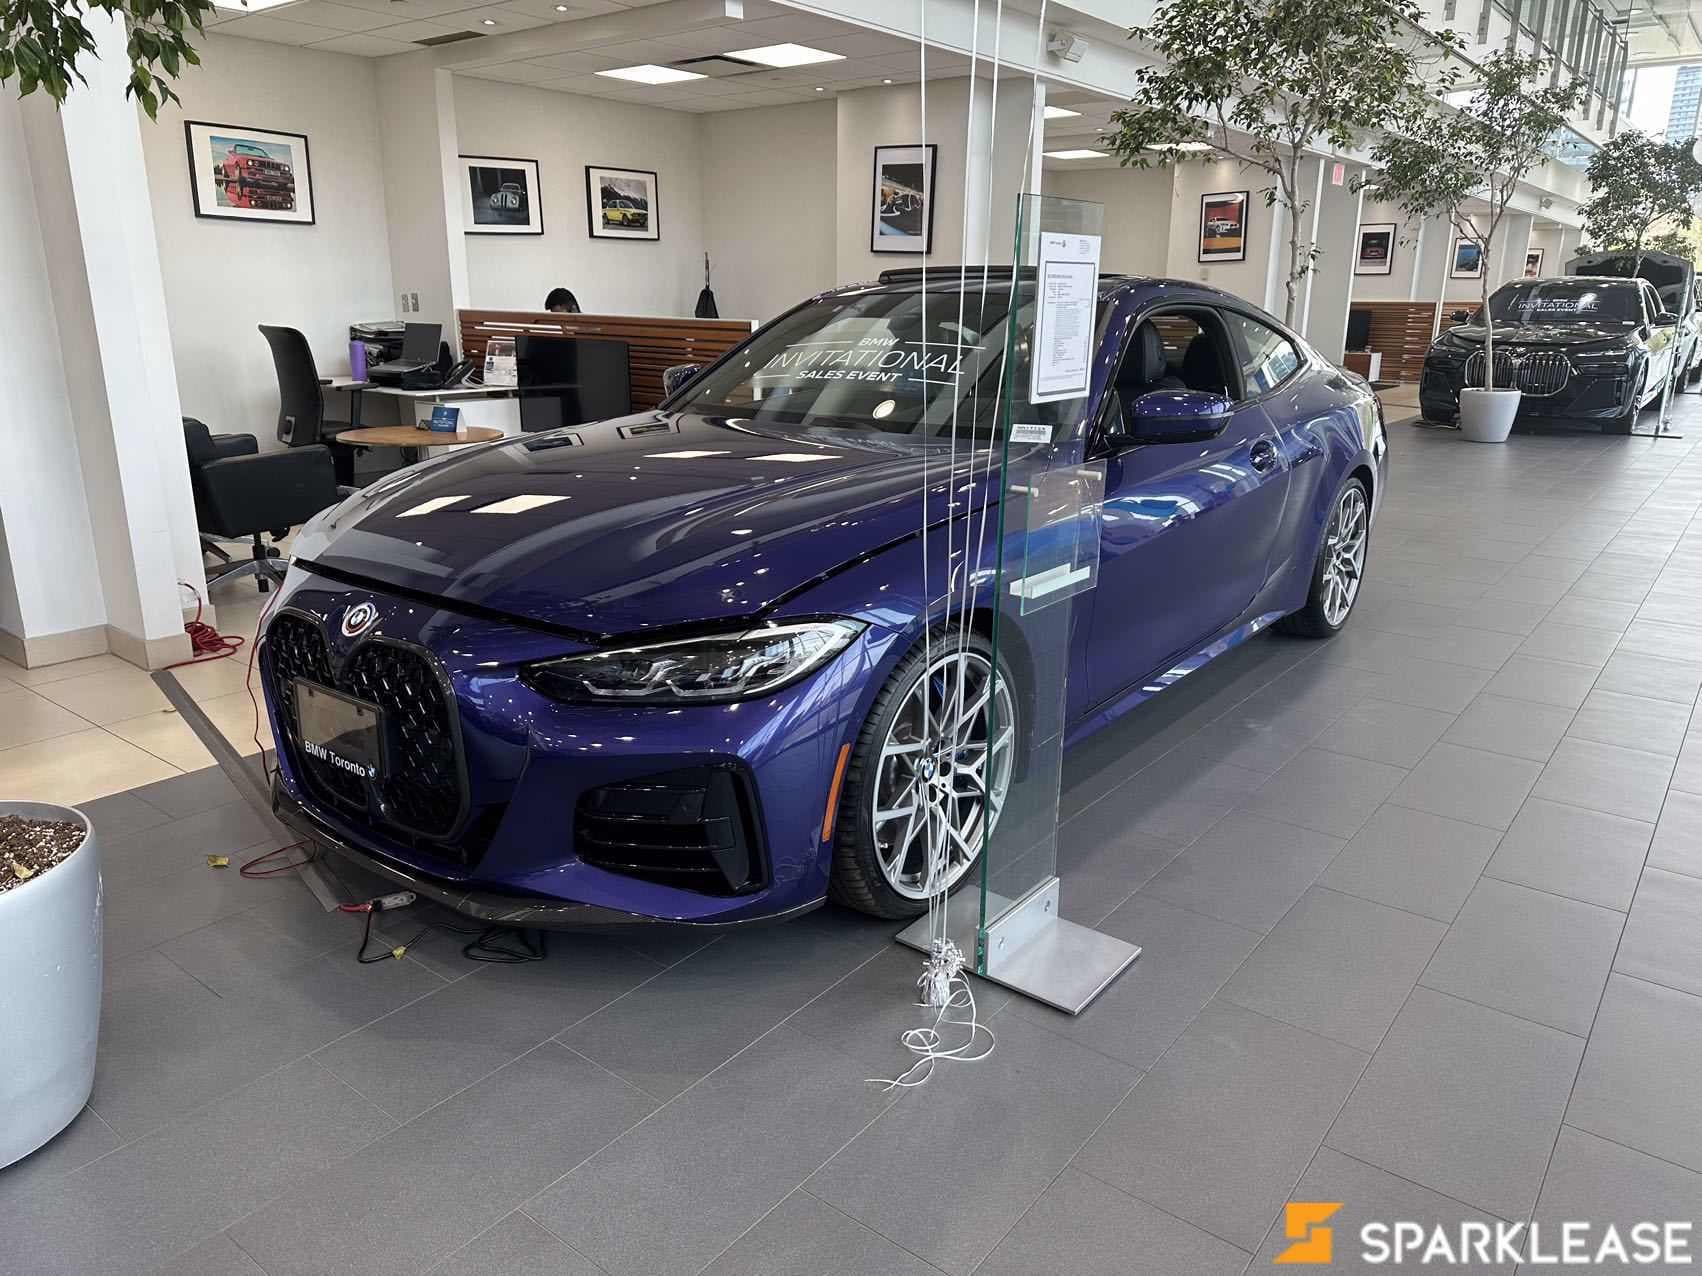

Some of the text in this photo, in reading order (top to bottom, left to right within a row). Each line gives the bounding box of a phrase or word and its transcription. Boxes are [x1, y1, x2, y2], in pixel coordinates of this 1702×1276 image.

[857, 337, 900, 346] BMW
[763, 350, 965, 375] INVITATIONAL
[795, 370, 903, 382] SALES EVENT
[304, 740, 366, 777] BMW Toronto
